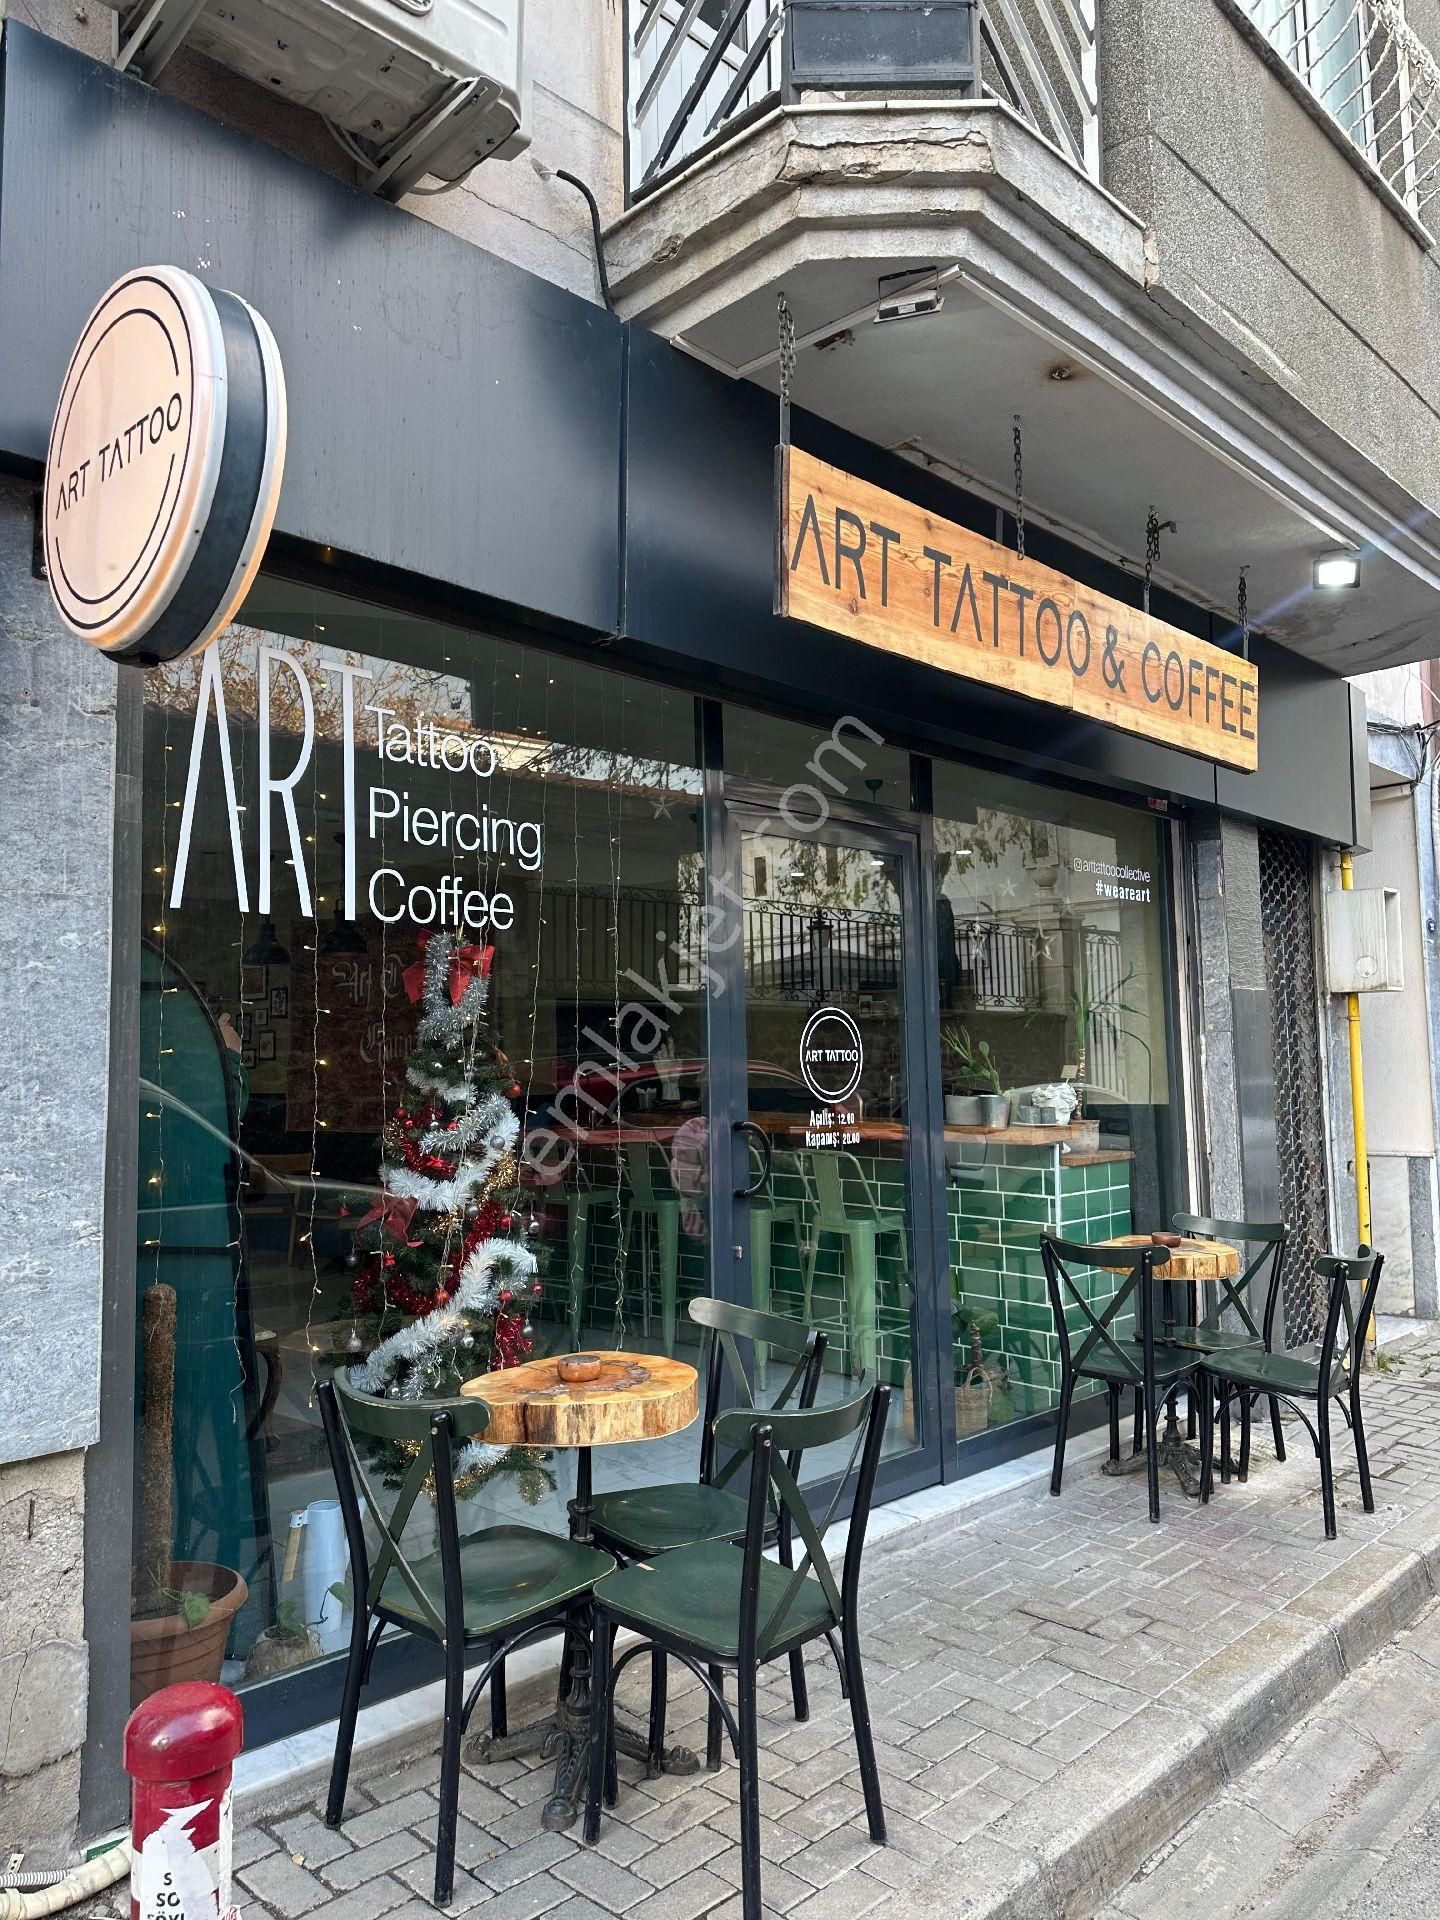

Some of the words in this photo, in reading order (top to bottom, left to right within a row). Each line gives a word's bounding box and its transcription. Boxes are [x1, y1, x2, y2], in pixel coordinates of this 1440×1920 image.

[56, 459, 91, 520] ART
[98, 392, 183, 483] TATTOO
[790, 493, 900, 608] ART
[922, 545, 1092, 677] TATTOO
[1101, 623, 1128, 693] &
[1141, 640, 1256, 741] COFFEE
[364, 704, 497, 778] Tattoo
[169, 640, 373, 921] ART
[368, 785, 543, 871] Piercing
[367, 868, 515, 931] Coffee
[1073, 857, 1151, 883] @arttattoocollective
[1095, 879, 1151, 903] #weareart
[805, 1050, 823, 1062] ART
[824, 1050, 859, 1062] TATTOO
